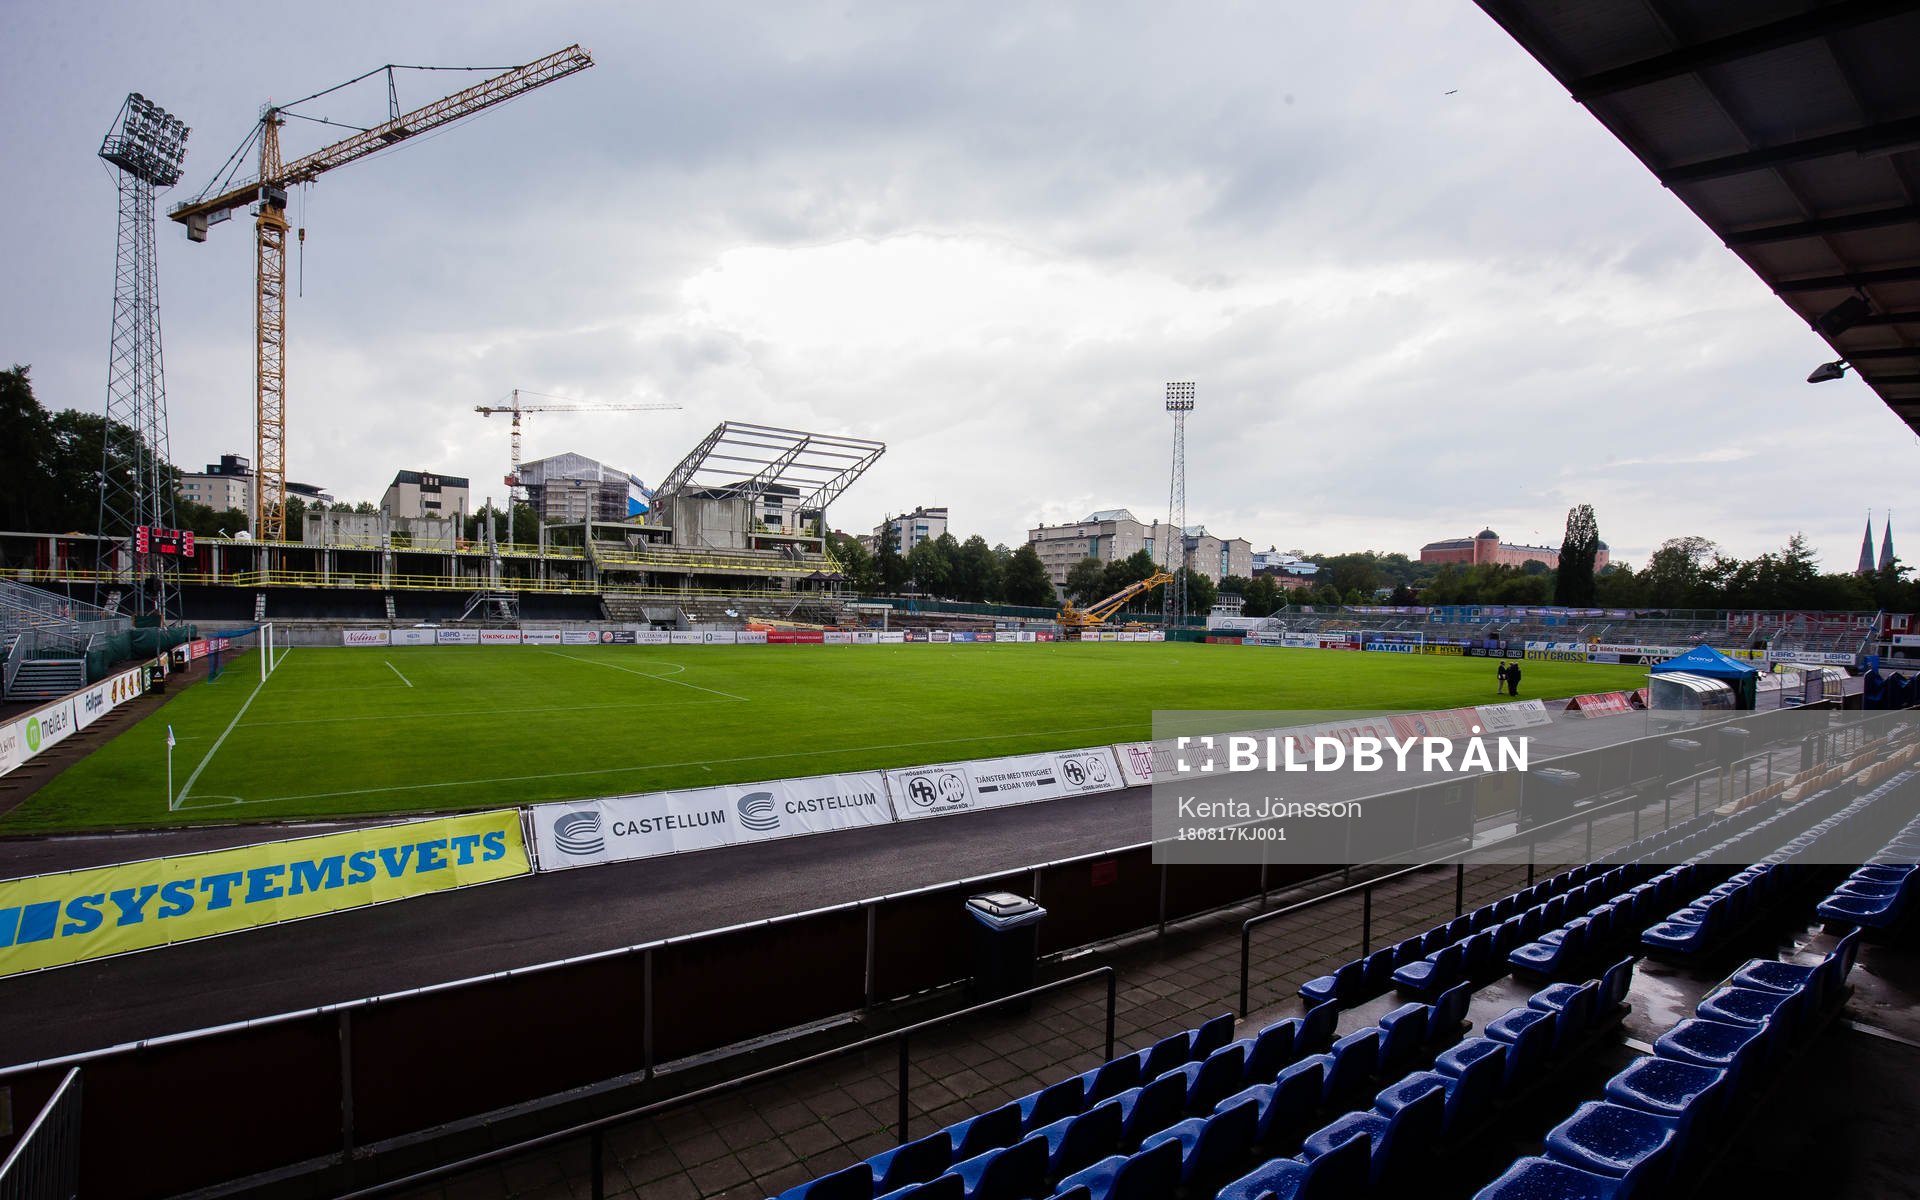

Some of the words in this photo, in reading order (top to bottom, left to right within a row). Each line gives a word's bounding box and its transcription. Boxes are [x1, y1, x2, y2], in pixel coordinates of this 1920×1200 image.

[1367, 643, 1411, 653] MATAKI
[1550, 651, 1584, 662] GROSS
[904, 769, 933, 777] HÖGBERGS
[975, 773, 1007, 784] TJÄNSTER
[1007, 771, 1021, 780] MED
[1021, 768, 1053, 778] TRYGGHET
[999, 781, 1021, 791] SEDAN
[784, 791, 876, 815] CASTELLUM
[929, 805, 958, 814] SÖDERLUNDS
[611, 808, 726, 837] CASTELLUM
[62, 830, 506, 938] SYSTEMSVETS
